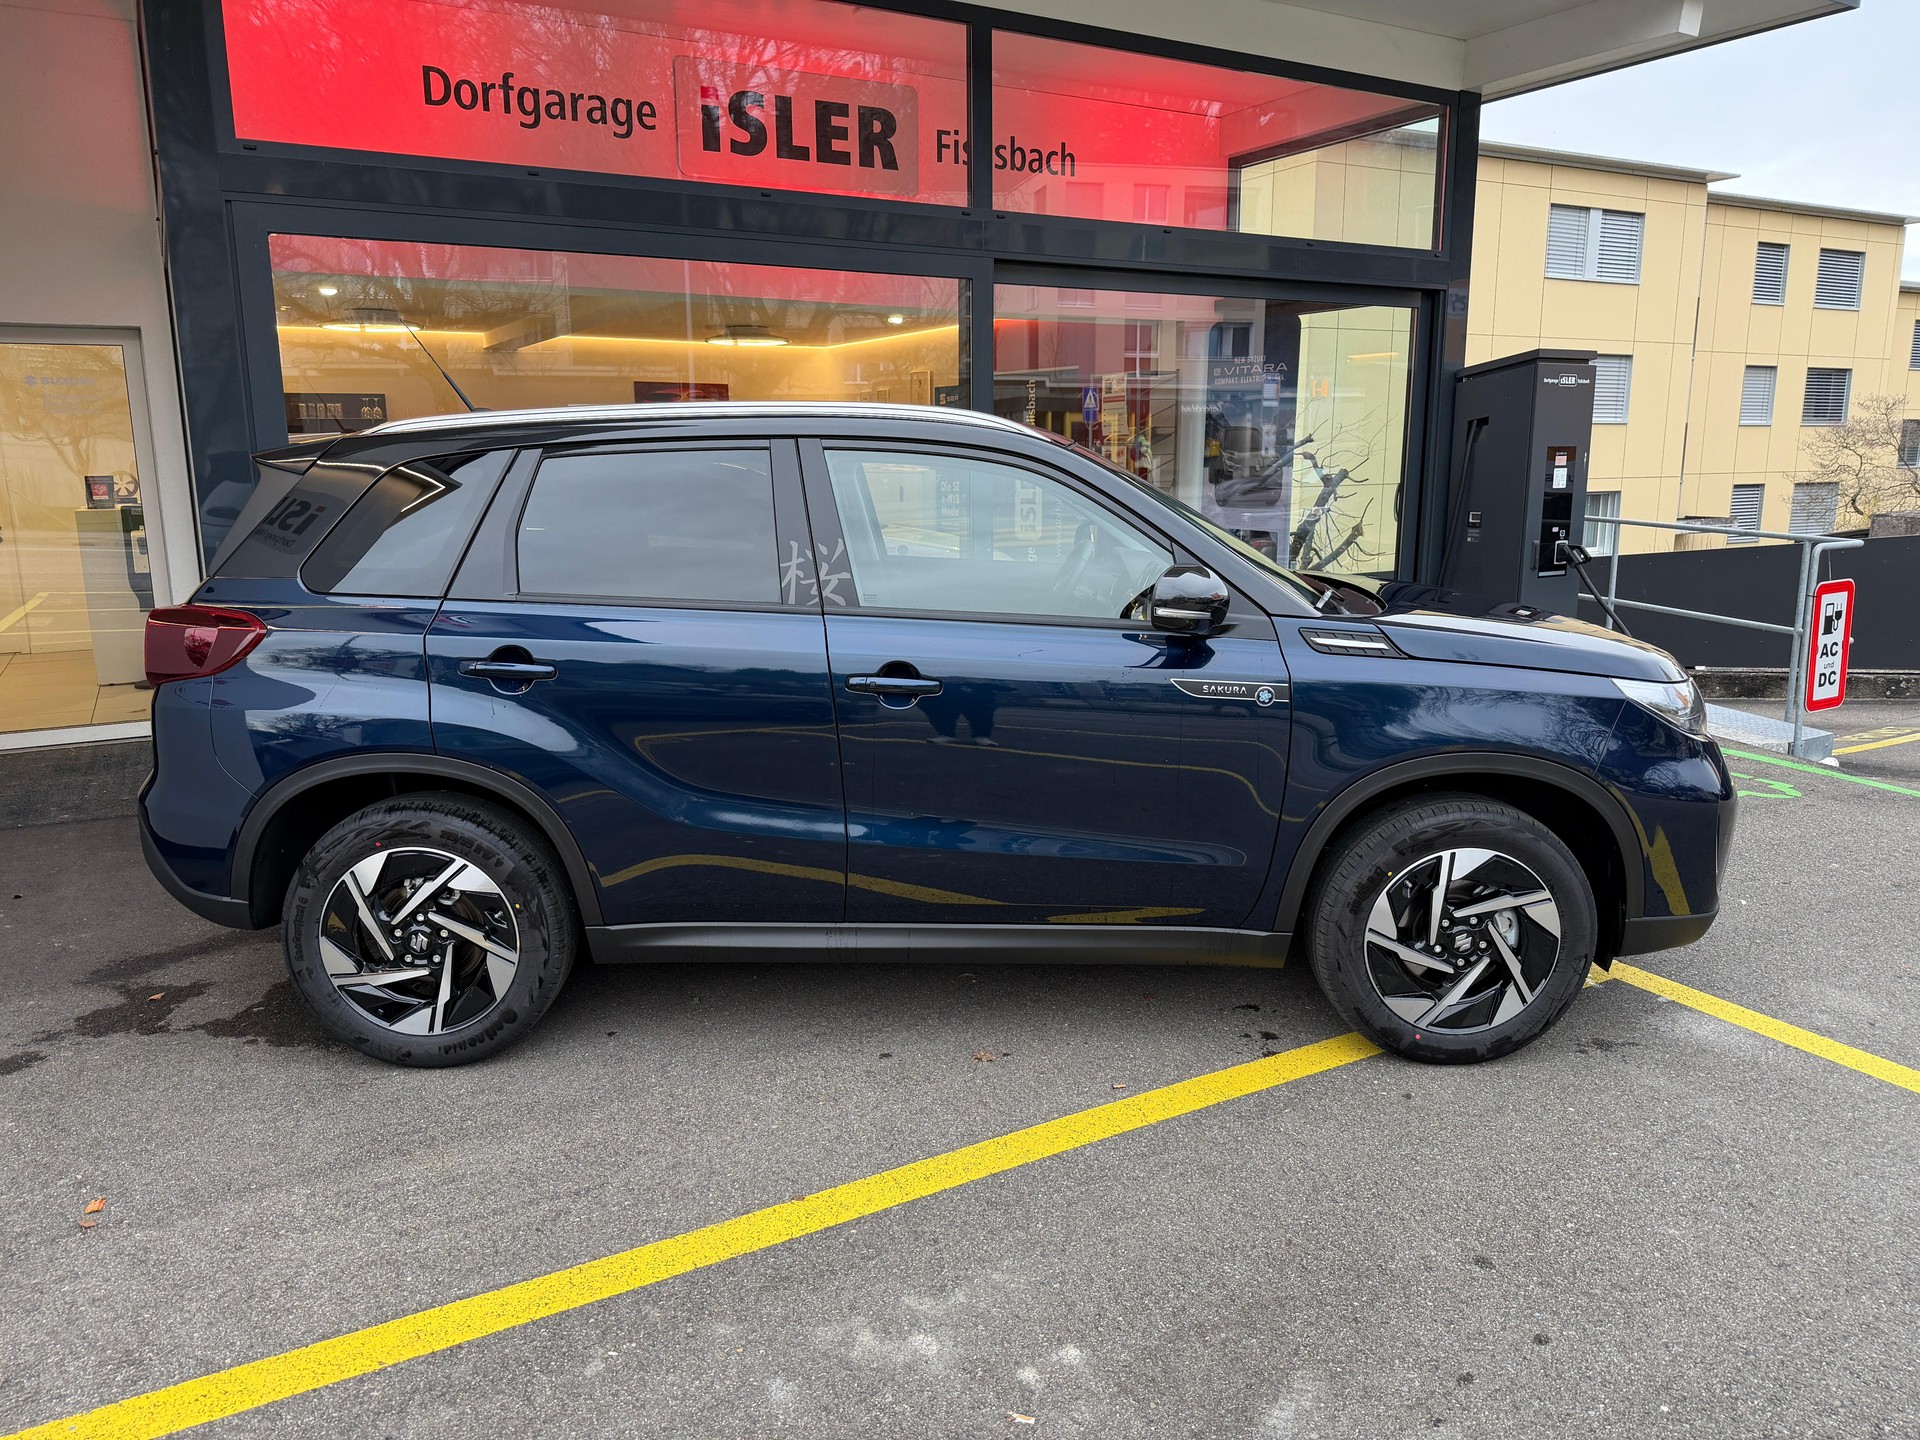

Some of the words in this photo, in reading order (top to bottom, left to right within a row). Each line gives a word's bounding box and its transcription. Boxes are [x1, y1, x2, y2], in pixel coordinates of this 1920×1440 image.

[422, 65, 657, 139] Dorfgarage
[700, 85, 899, 171] iSLER
[779, 538, 852, 606] 桜
[1820, 642, 1839, 658] AC
[1823, 661, 1835, 669] und
[1818, 671, 1837, 687] DC
[1202, 685, 1248, 694] SAKURA
